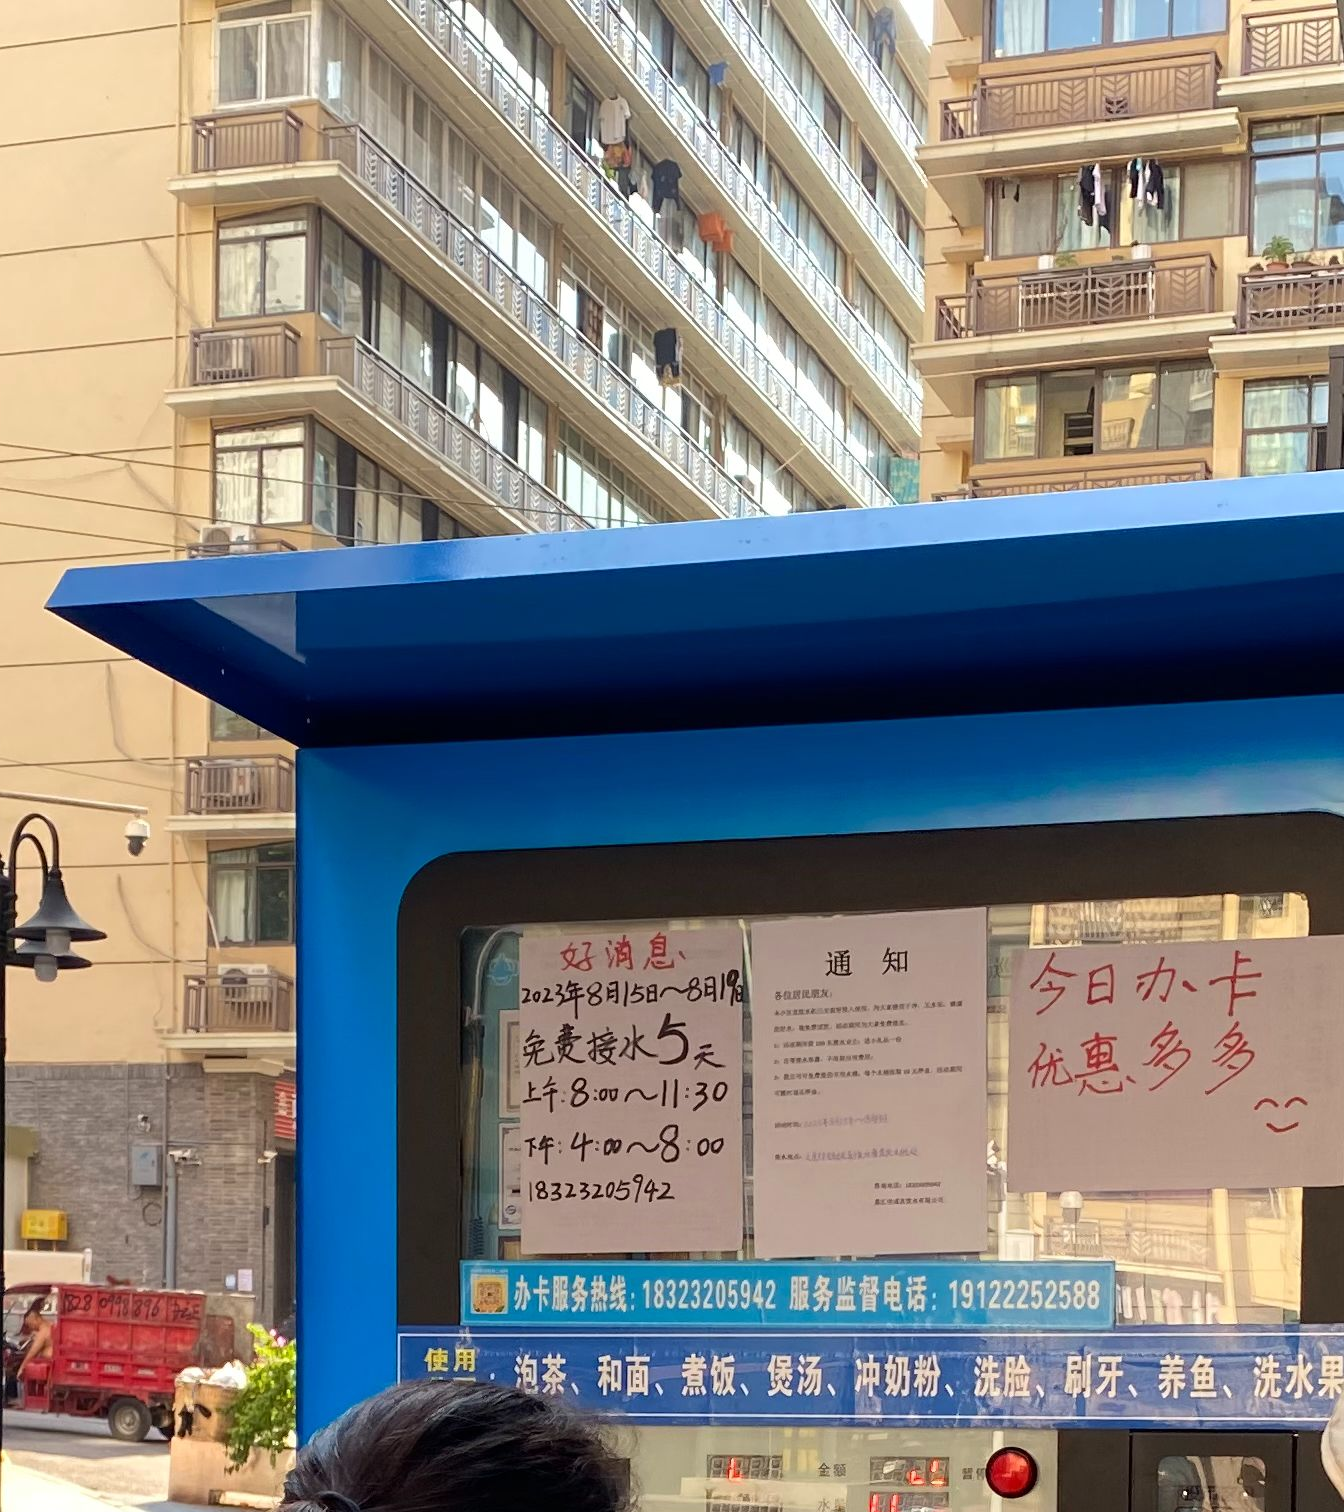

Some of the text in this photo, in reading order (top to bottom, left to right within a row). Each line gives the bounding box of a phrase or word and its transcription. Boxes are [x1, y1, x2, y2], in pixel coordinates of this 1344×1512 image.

[560, 932, 686, 971] 好消息
[1030, 951, 1262, 1016] 今日办卡
[522, 1012, 726, 1070] 免费接水5天
[1027, 1020, 1255, 1096] 优惠多多
[528, 1173, 675, 1203] 18323205942
[424, 1348, 477, 1373] 使用
